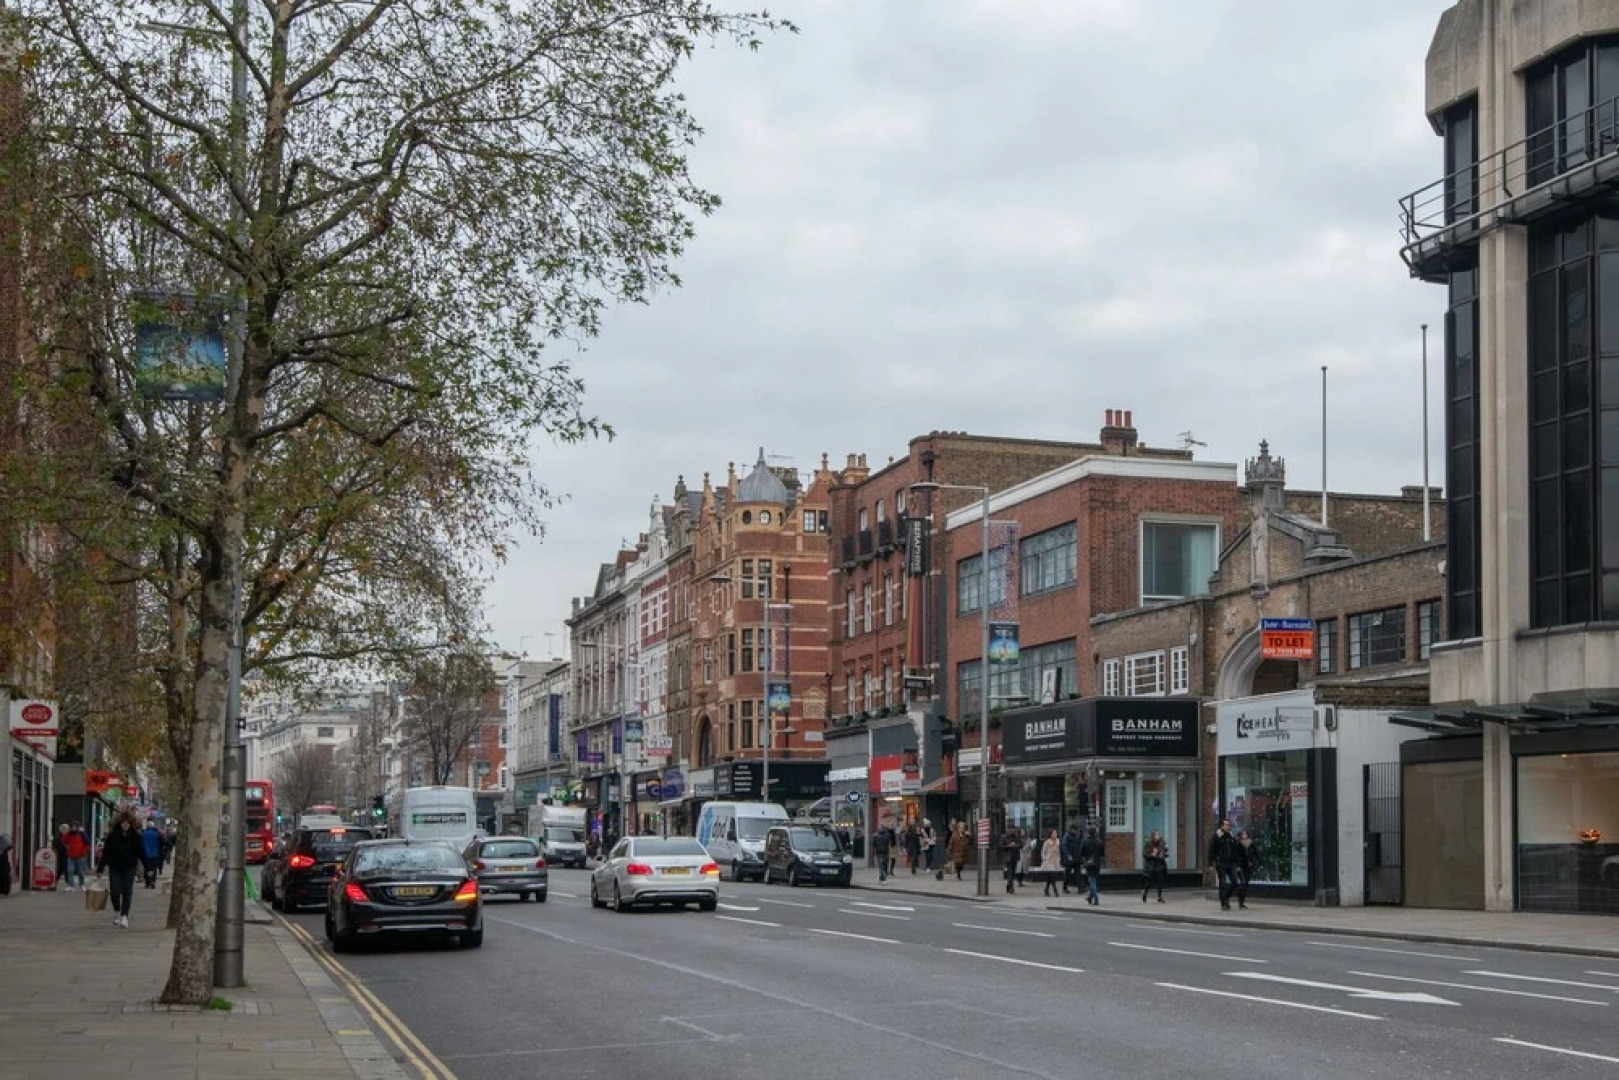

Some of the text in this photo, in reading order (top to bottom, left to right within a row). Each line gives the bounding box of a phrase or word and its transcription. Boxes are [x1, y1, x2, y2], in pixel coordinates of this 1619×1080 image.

[1268, 637, 1305, 647] TO LET
[1025, 718, 1066, 740] BANHAM
[1111, 719, 1183, 731] BANHAM
[416, 815, 466, 823] enterprise
